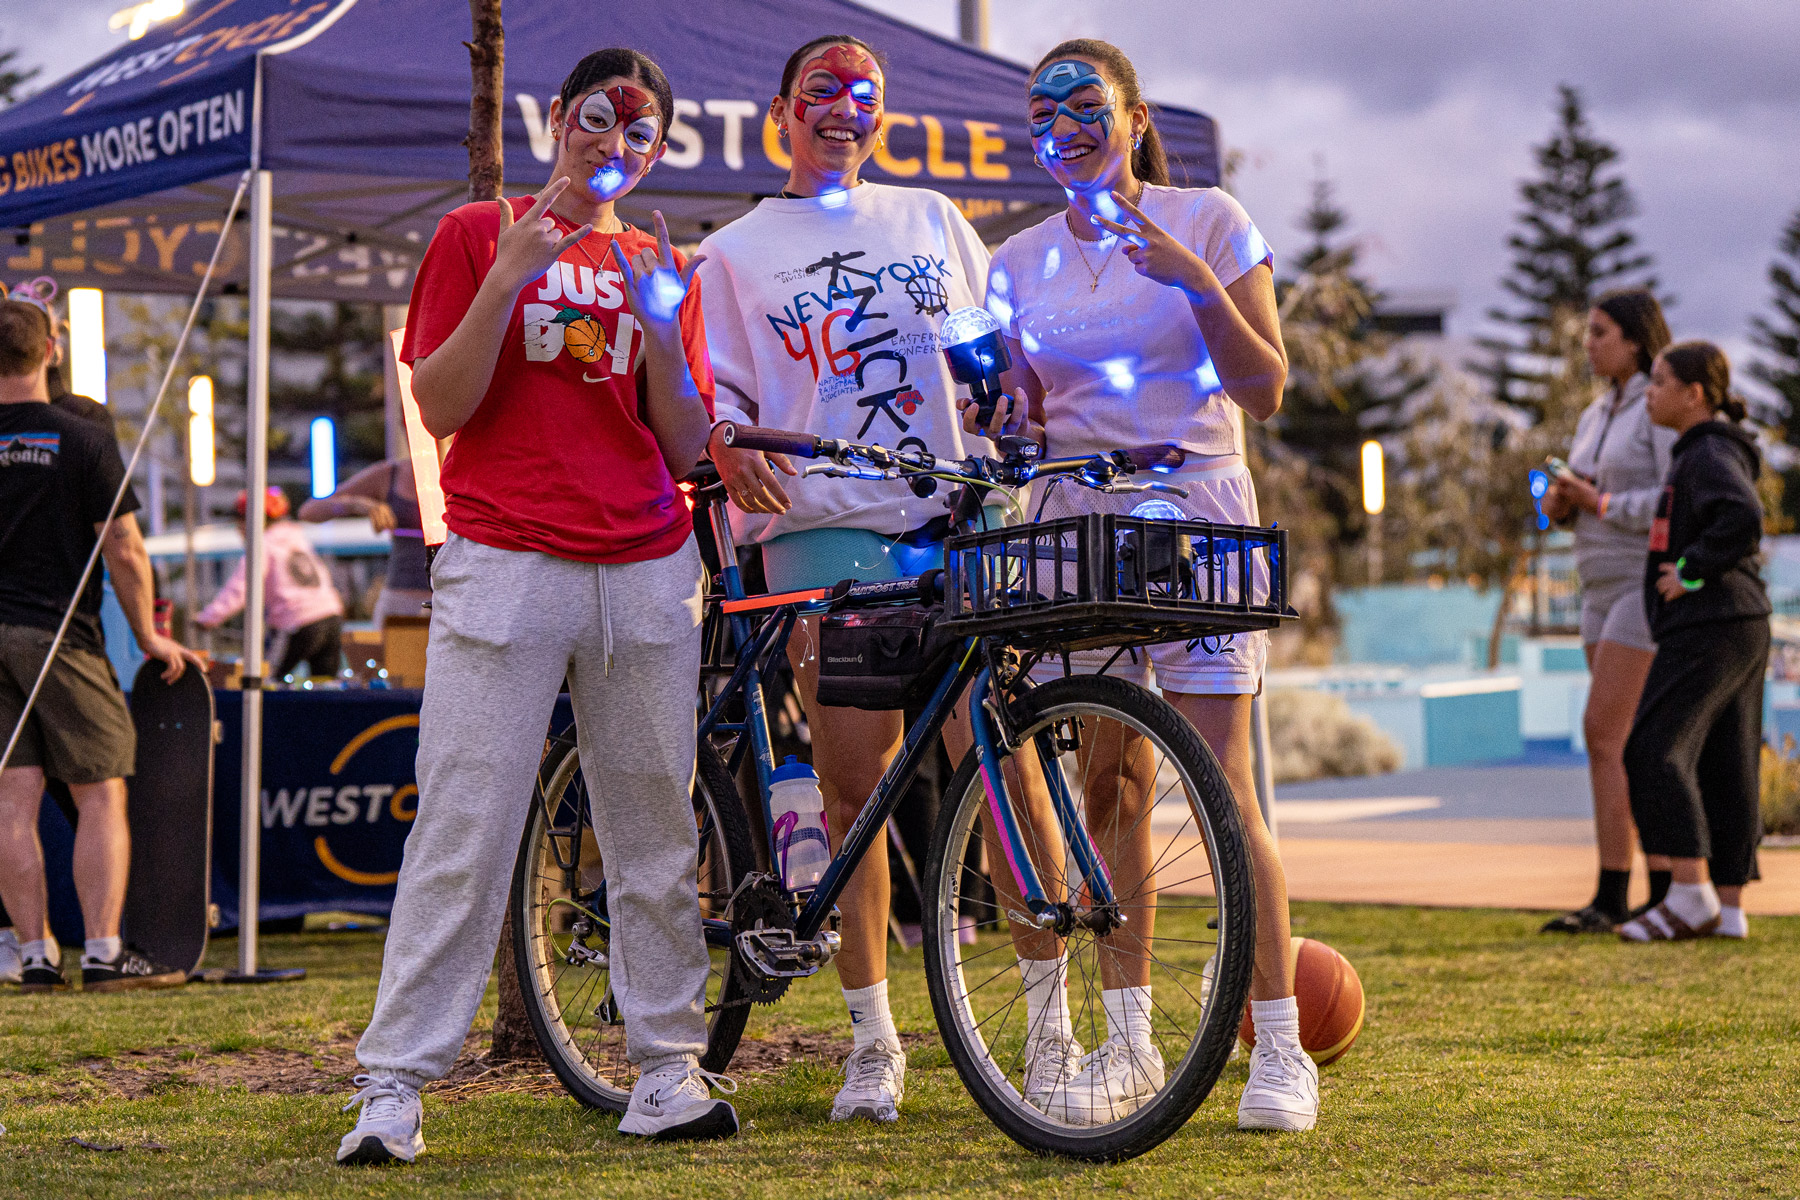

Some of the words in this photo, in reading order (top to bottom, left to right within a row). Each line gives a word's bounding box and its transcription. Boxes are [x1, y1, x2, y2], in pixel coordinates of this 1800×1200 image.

[13, 138, 82, 193] BIKES
[81, 117, 157, 177] MORE
[158, 89, 245, 155] OFTEN
[538, 261, 625, 310] JUS
[766, 276, 855, 341] NEW
[861, 253, 952, 293] YORK
[891, 332, 941, 346] EASTERN
